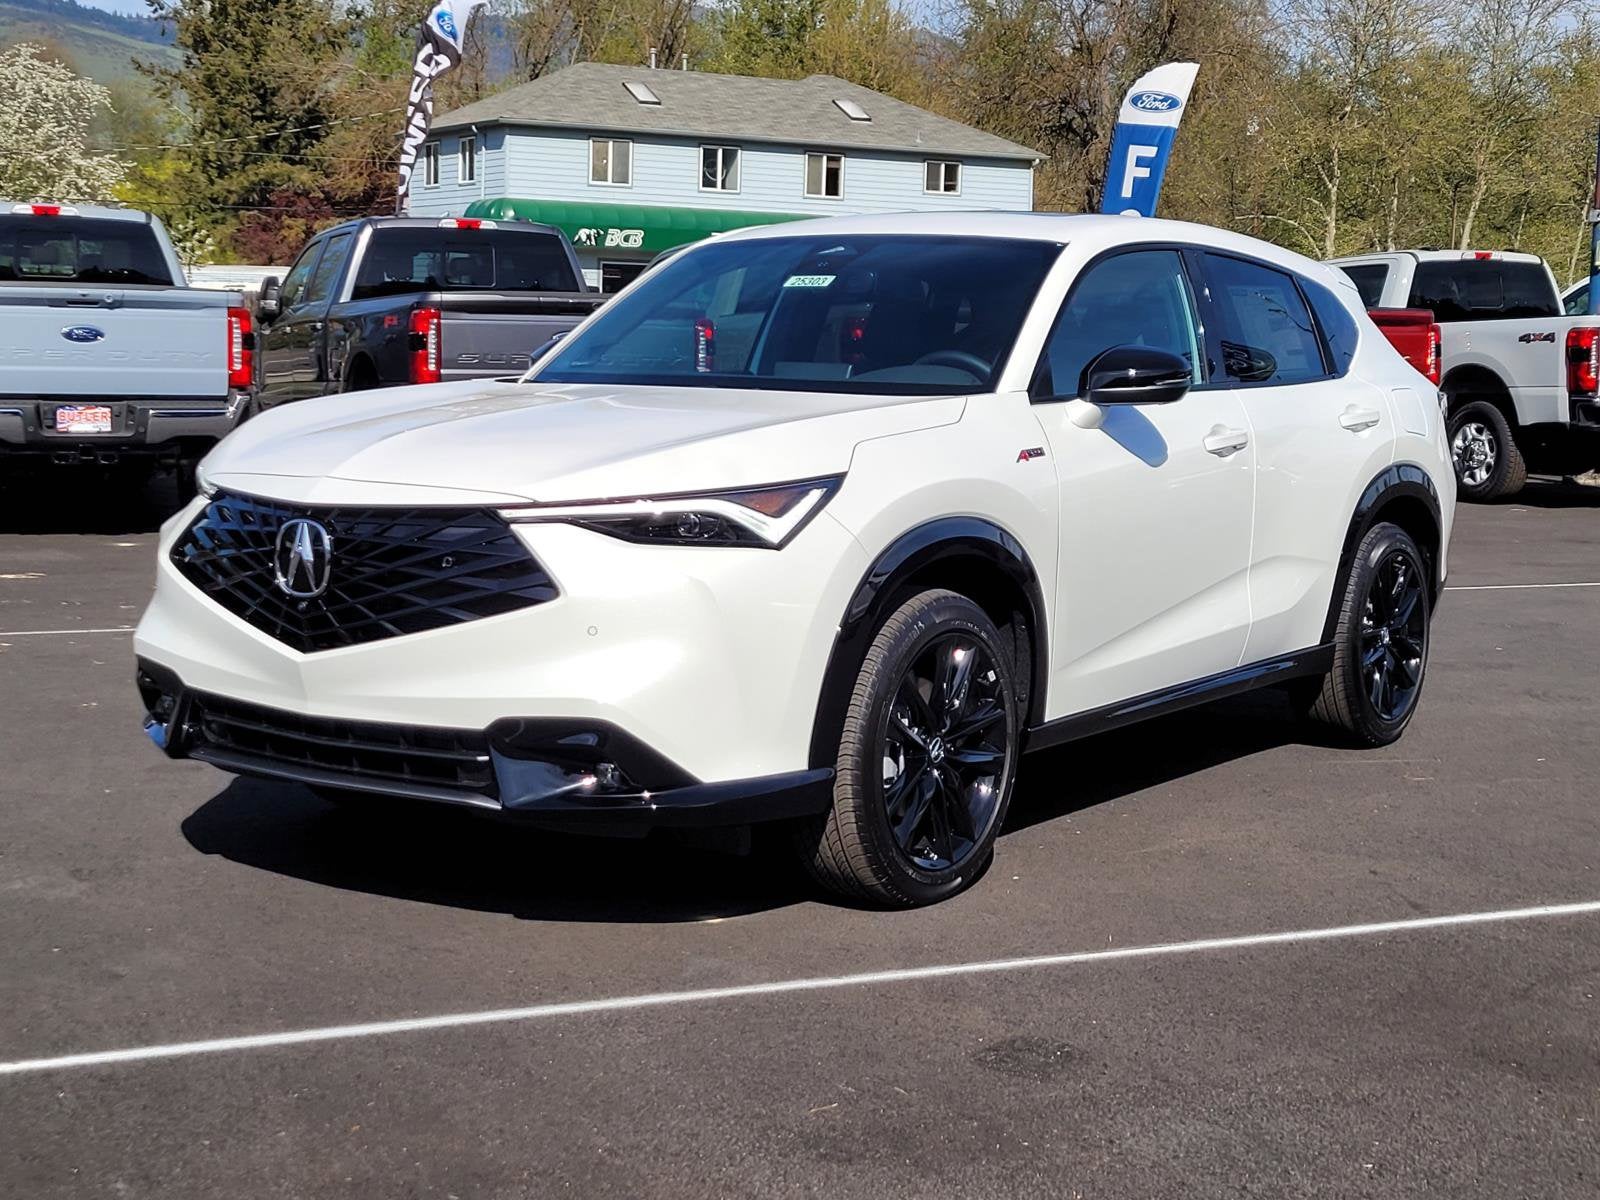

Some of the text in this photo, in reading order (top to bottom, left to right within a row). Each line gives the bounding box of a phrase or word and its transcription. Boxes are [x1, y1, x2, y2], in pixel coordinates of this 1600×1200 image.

[604, 228, 645, 248] BCB
[790, 277, 829, 286] 25303
[58, 411, 110, 422] BUTLER
